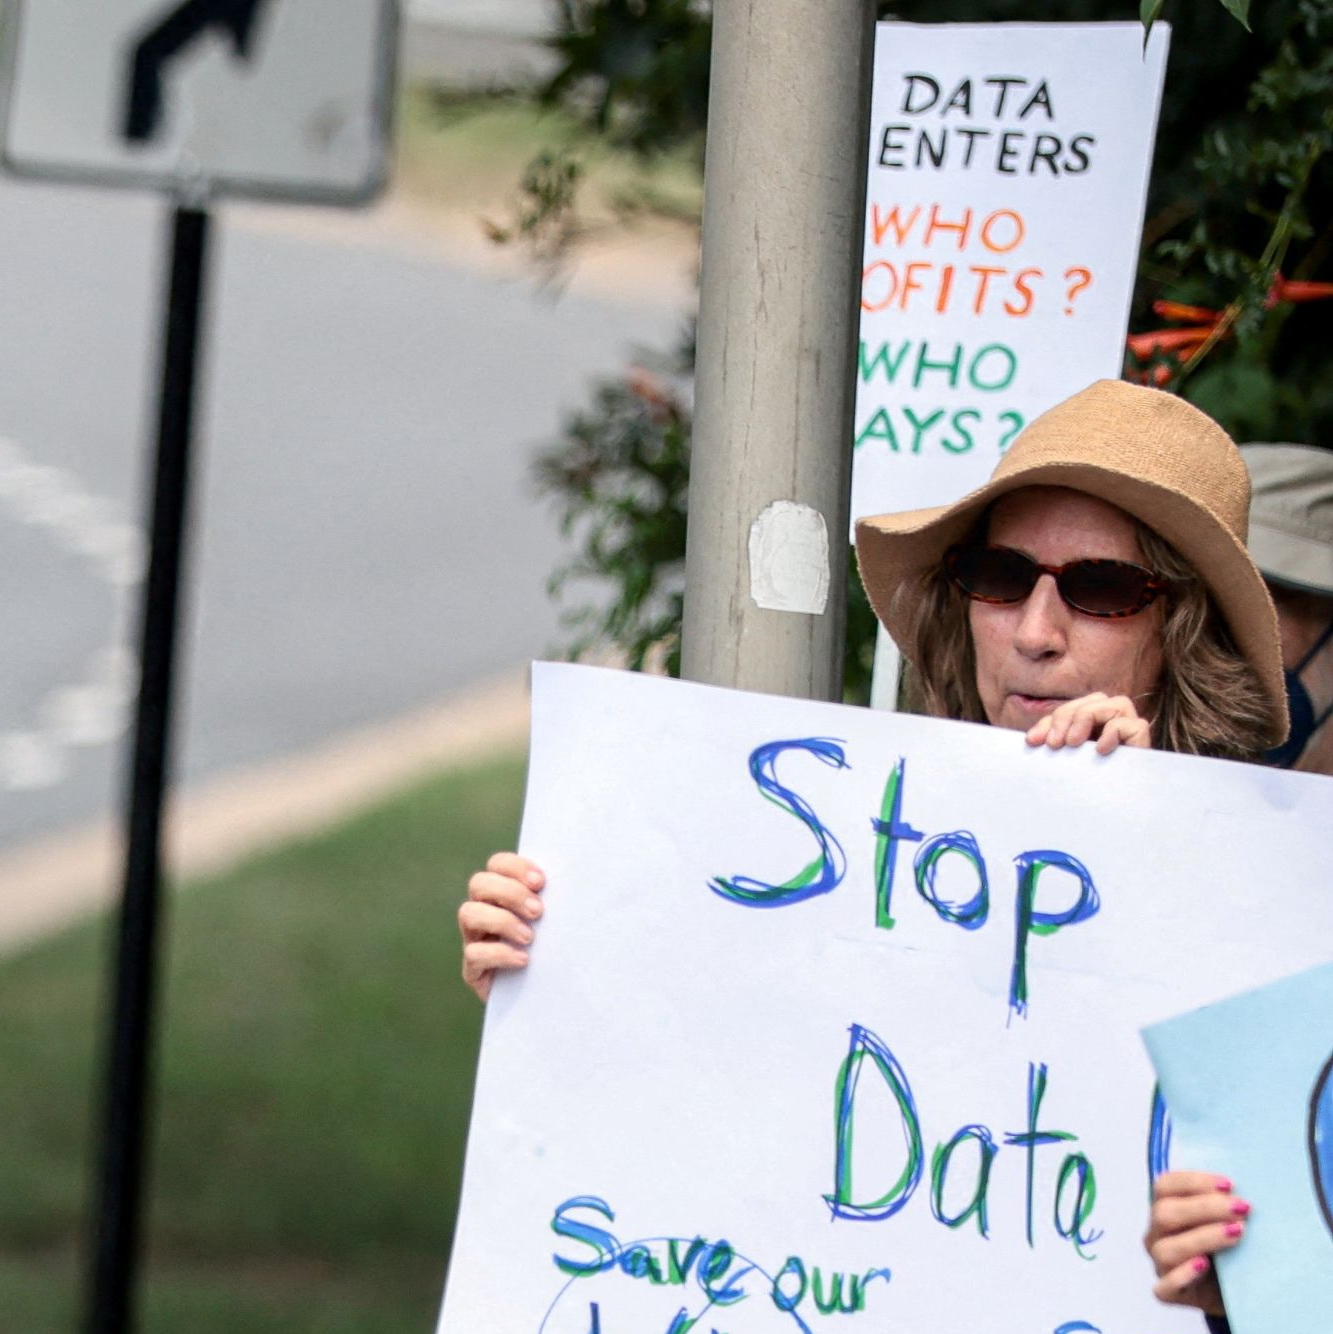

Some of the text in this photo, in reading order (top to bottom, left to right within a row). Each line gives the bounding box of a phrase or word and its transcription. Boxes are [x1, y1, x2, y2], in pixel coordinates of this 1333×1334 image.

[902, 74, 1054, 121] DATA
[878, 126, 1096, 178] ENTERS
[873, 203, 1026, 254] WHO
[859, 340, 1018, 392] WHO
[708, 736, 1100, 1027] Stop
[823, 1023, 1103, 1260] Data
[552, 1195, 891, 1315] Save our
